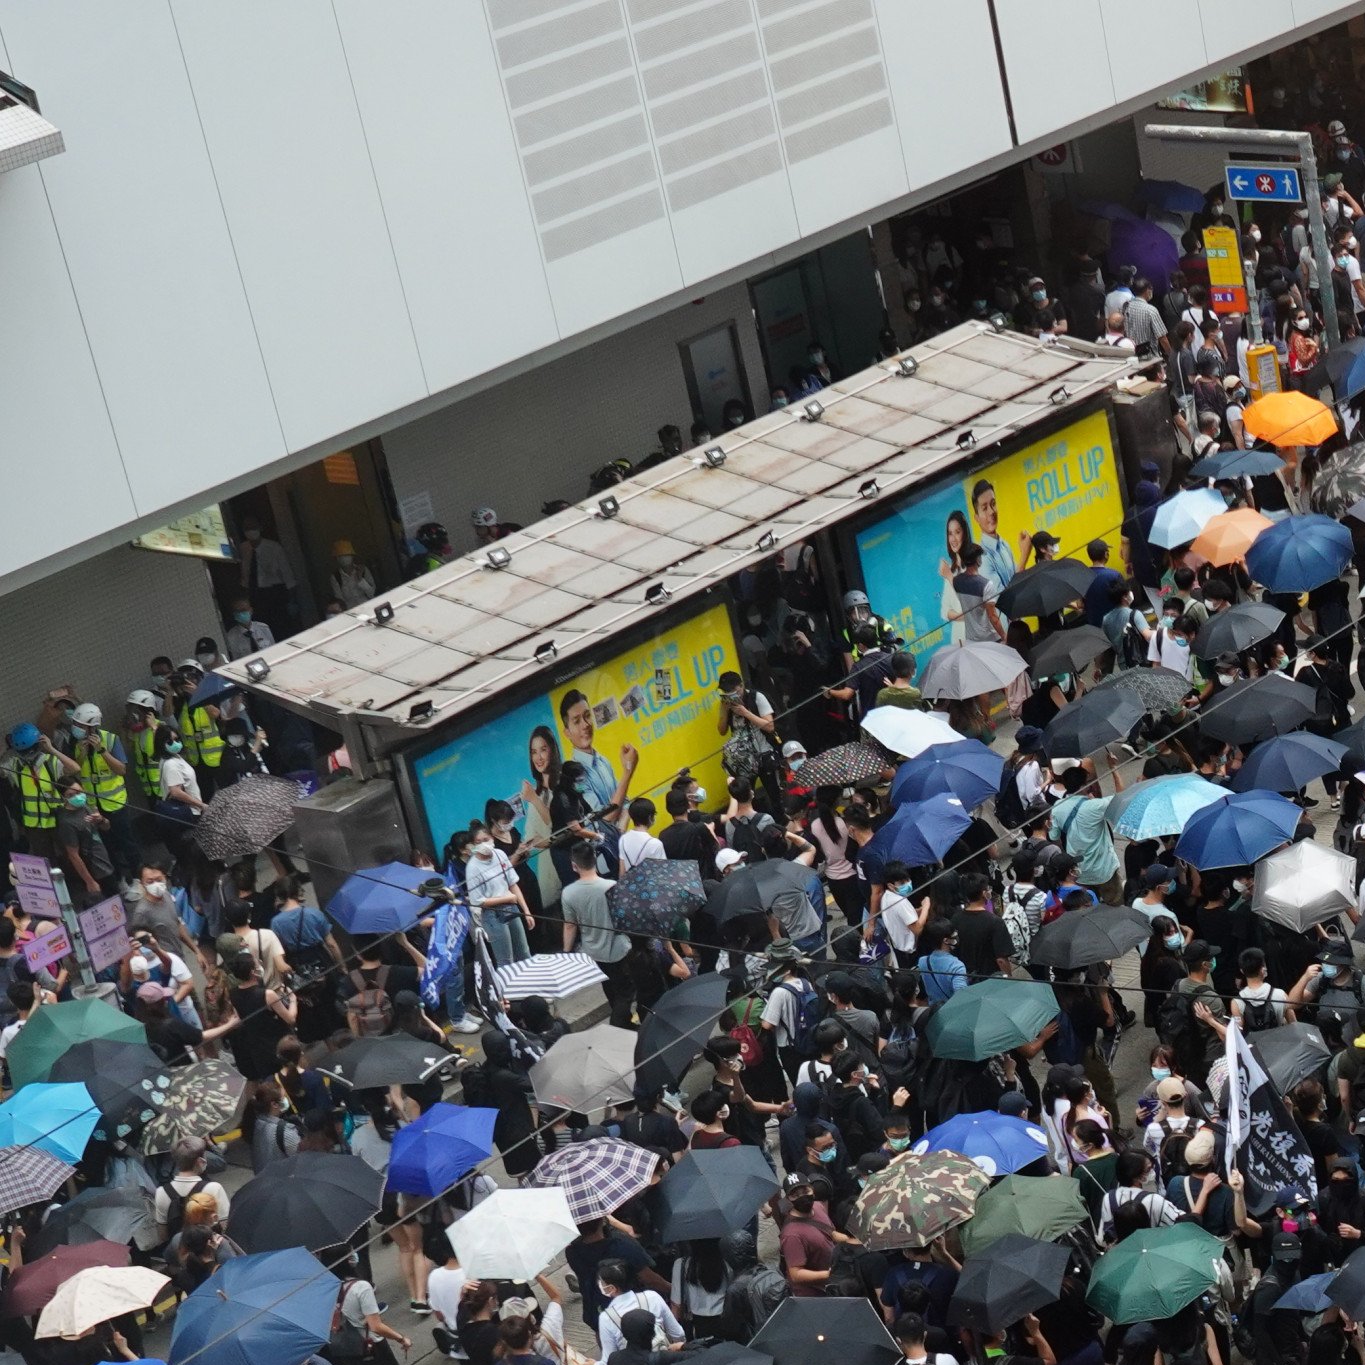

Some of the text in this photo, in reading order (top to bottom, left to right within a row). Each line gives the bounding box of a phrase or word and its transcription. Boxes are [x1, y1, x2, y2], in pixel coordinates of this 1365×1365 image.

[1026, 445, 1105, 512] ROLL UP
[693, 644, 726, 688] UP
[787, 1173, 800, 1186] NY
